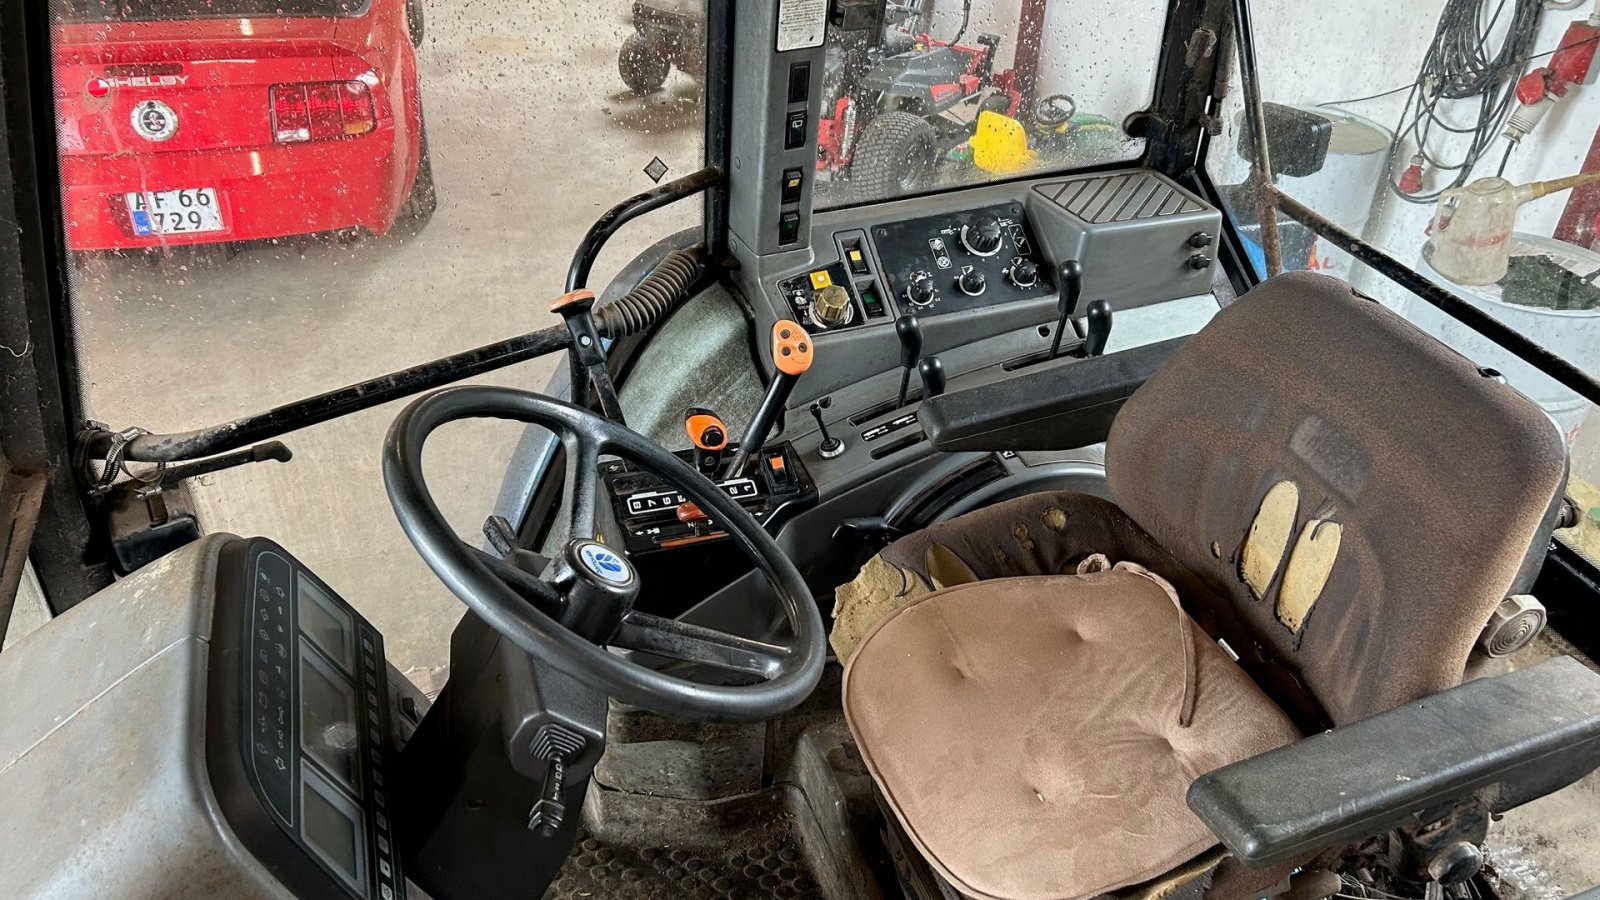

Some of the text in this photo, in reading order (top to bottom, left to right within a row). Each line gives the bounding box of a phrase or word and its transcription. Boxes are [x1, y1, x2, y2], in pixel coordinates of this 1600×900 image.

[105, 75, 189, 87] SHELBY
[179, 188, 210, 207] 66
[154, 211, 201, 231] 729
[633, 501, 642, 509] 8
[647, 499, 657, 508] 7
[662, 496, 672, 506] 6
[729, 486, 739, 495] 2
